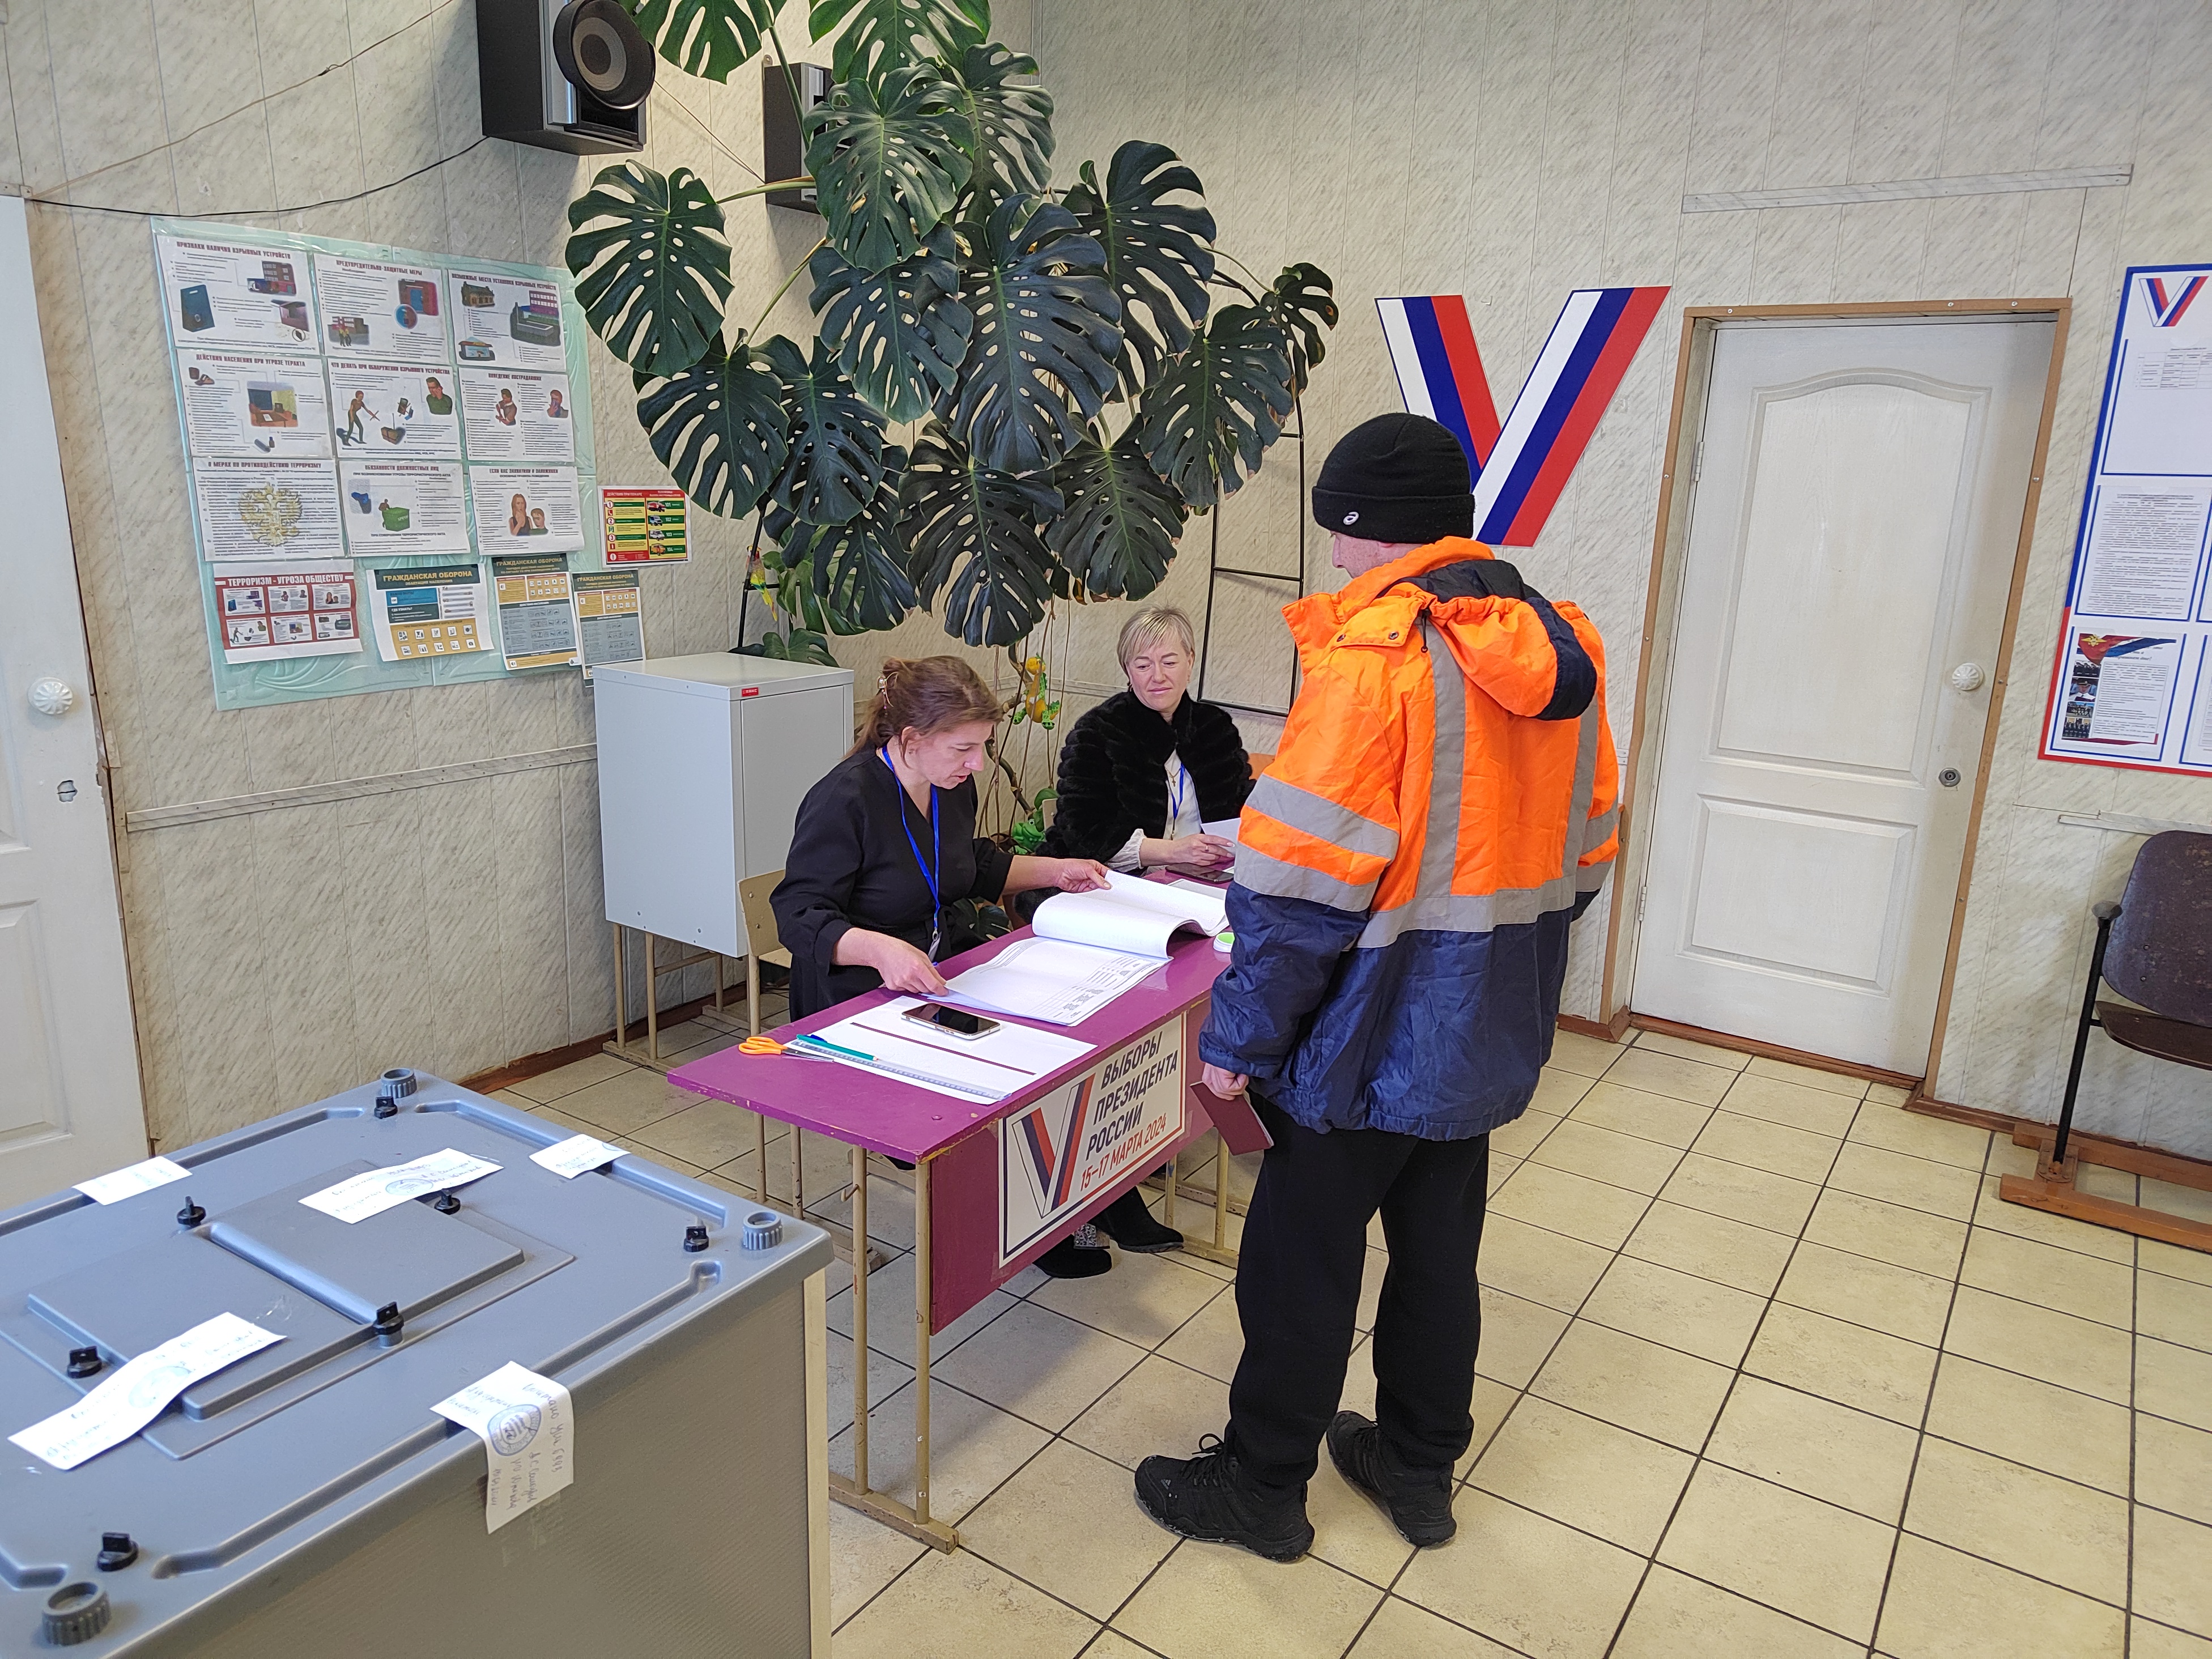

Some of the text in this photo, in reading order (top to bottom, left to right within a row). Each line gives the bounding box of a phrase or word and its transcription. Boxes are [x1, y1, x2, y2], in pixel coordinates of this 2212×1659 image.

[176, 241, 205, 250] ПРИЗНАКИ
[228, 577, 272, 587] ТЕРРОРИЗМ
[277, 575, 304, 585] УГРОЗА
[305, 574, 343, 584] ОБЩЕСТВУ
[383, 572, 437, 582] ГРАЖДАНСКАЯ
[1093, 1050, 1178, 1125] ПРЕЗИДЕНТА
[1100, 1031, 1162, 1090] ВЫБОРЫ
[1086, 1101, 1144, 1161] РОССИИ
[1109, 1130, 1143, 1171] МАРТА
[1144, 1112, 1167, 1145] 2024
